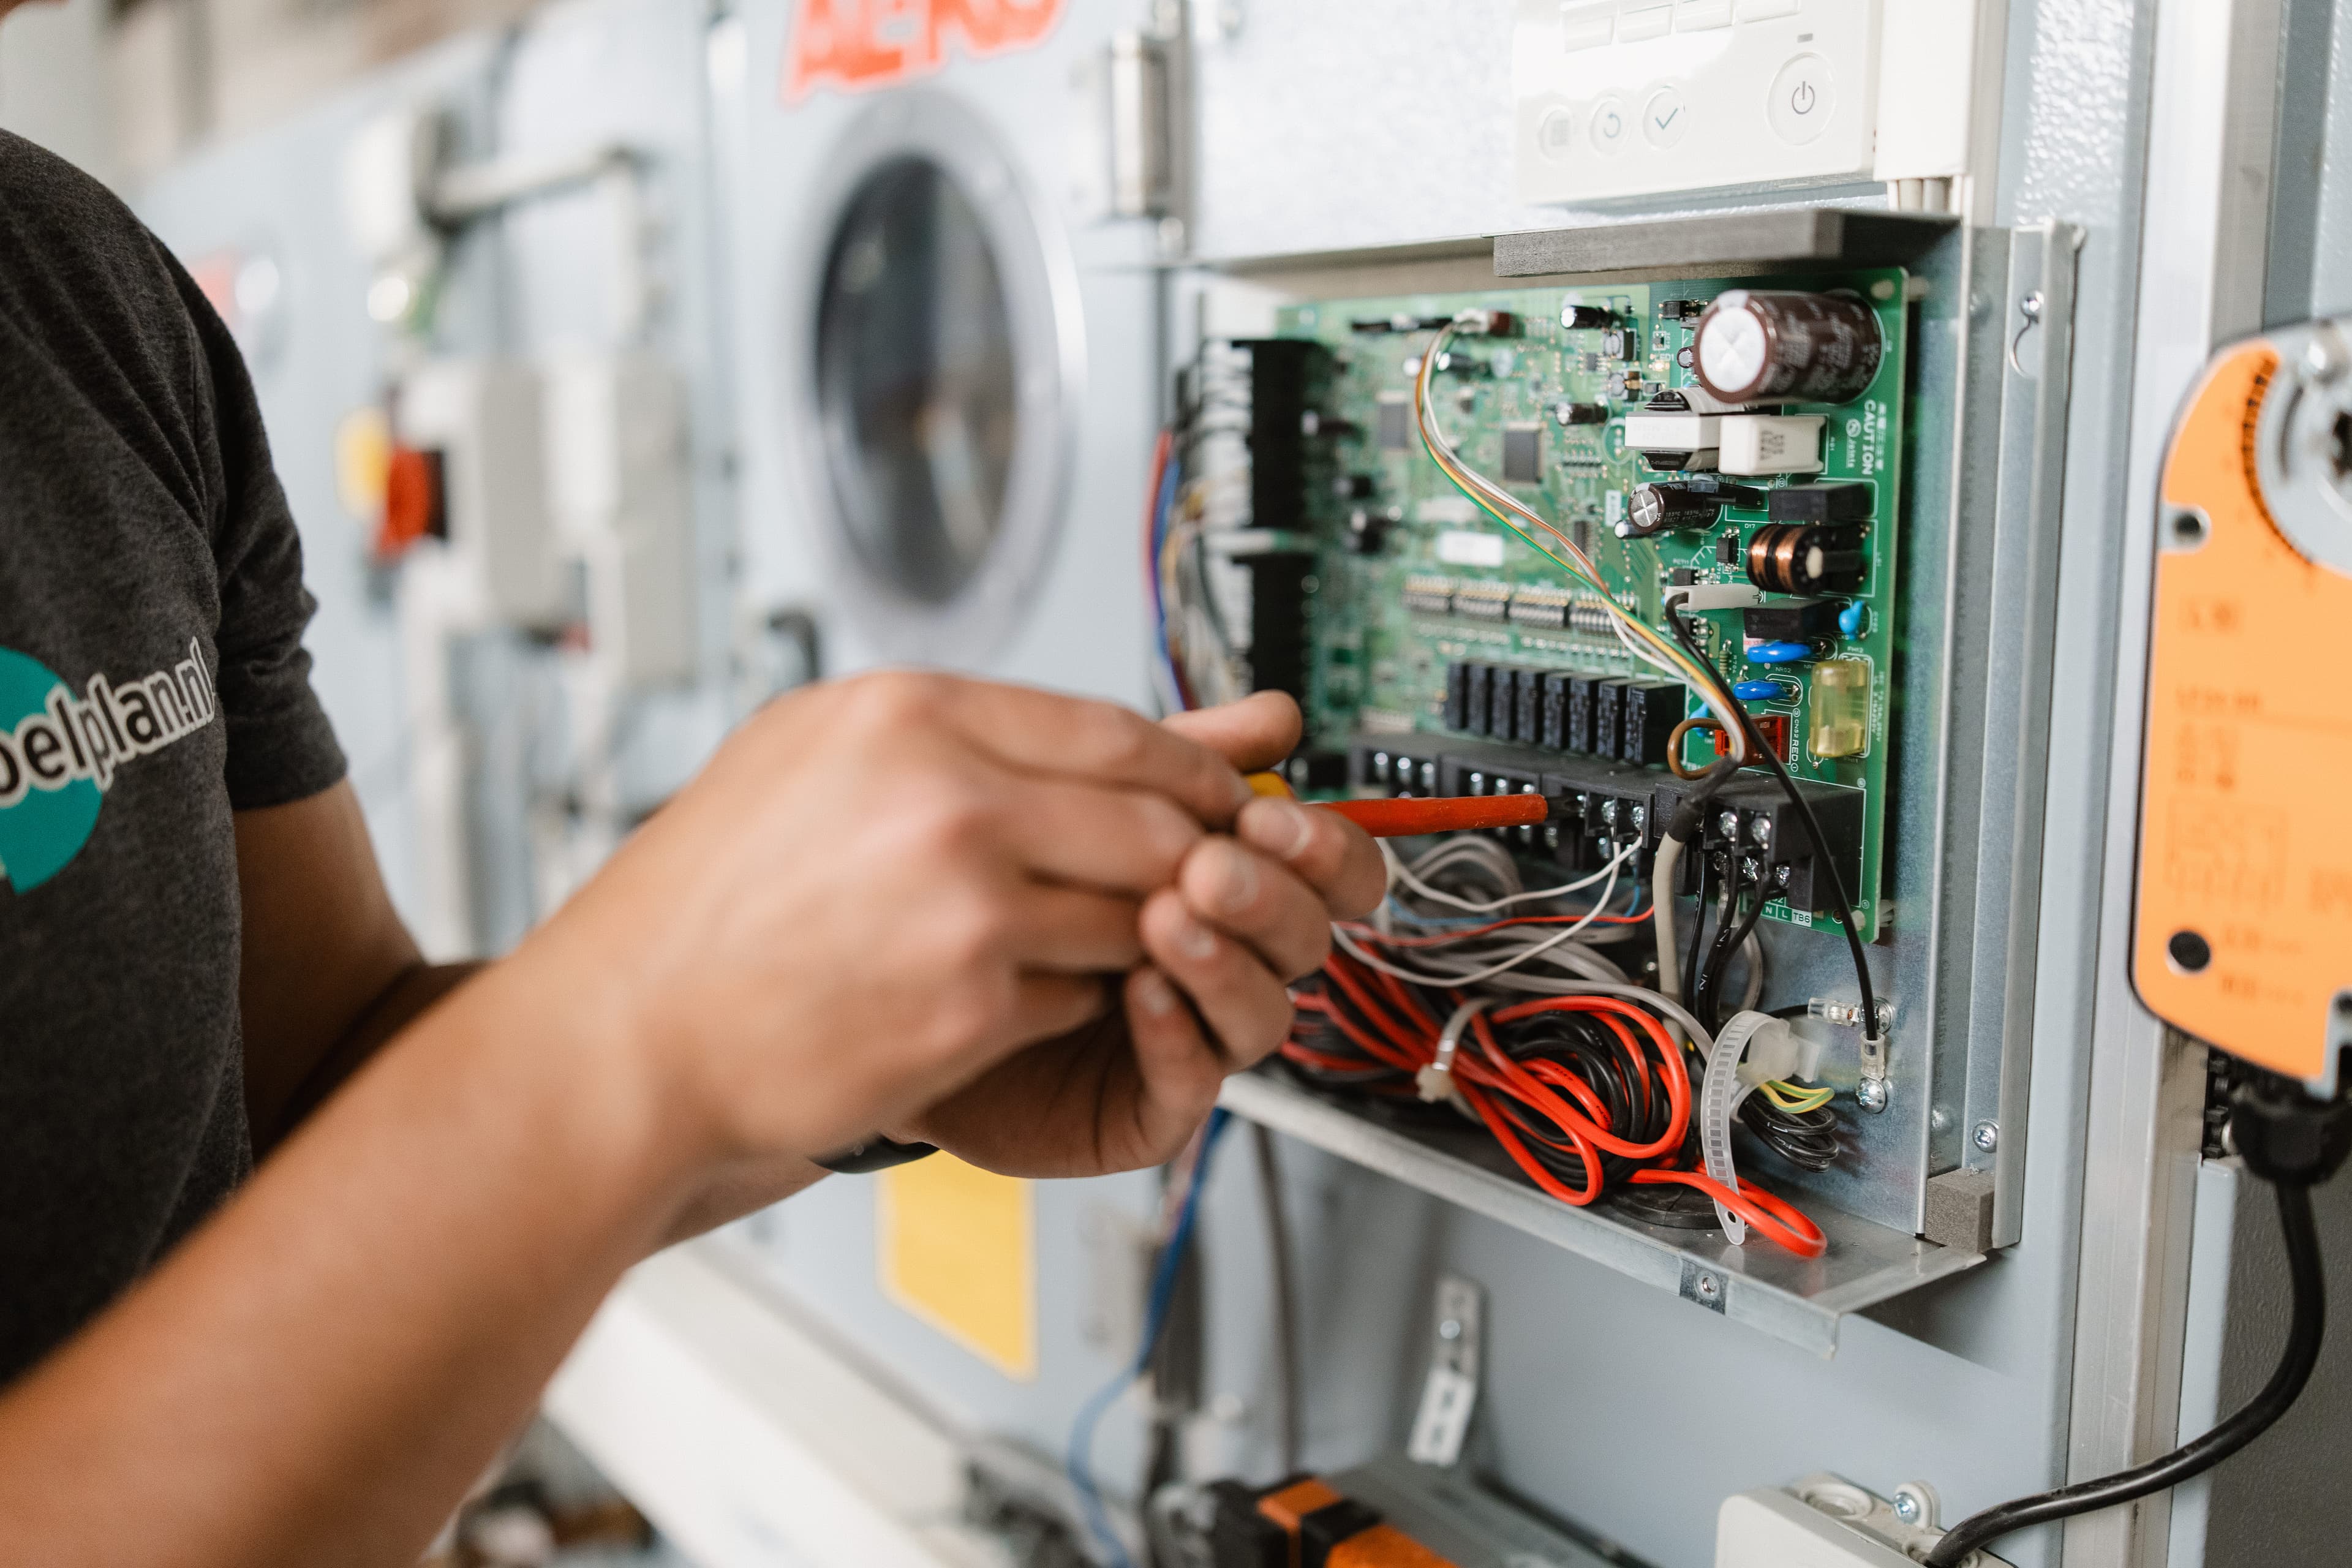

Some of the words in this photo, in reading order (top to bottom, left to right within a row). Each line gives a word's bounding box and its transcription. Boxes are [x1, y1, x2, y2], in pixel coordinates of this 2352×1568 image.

[1861, 399, 1877, 475] CAUTION
[1765, 906, 1773, 914] N
[1793, 911, 1811, 924] TB6
